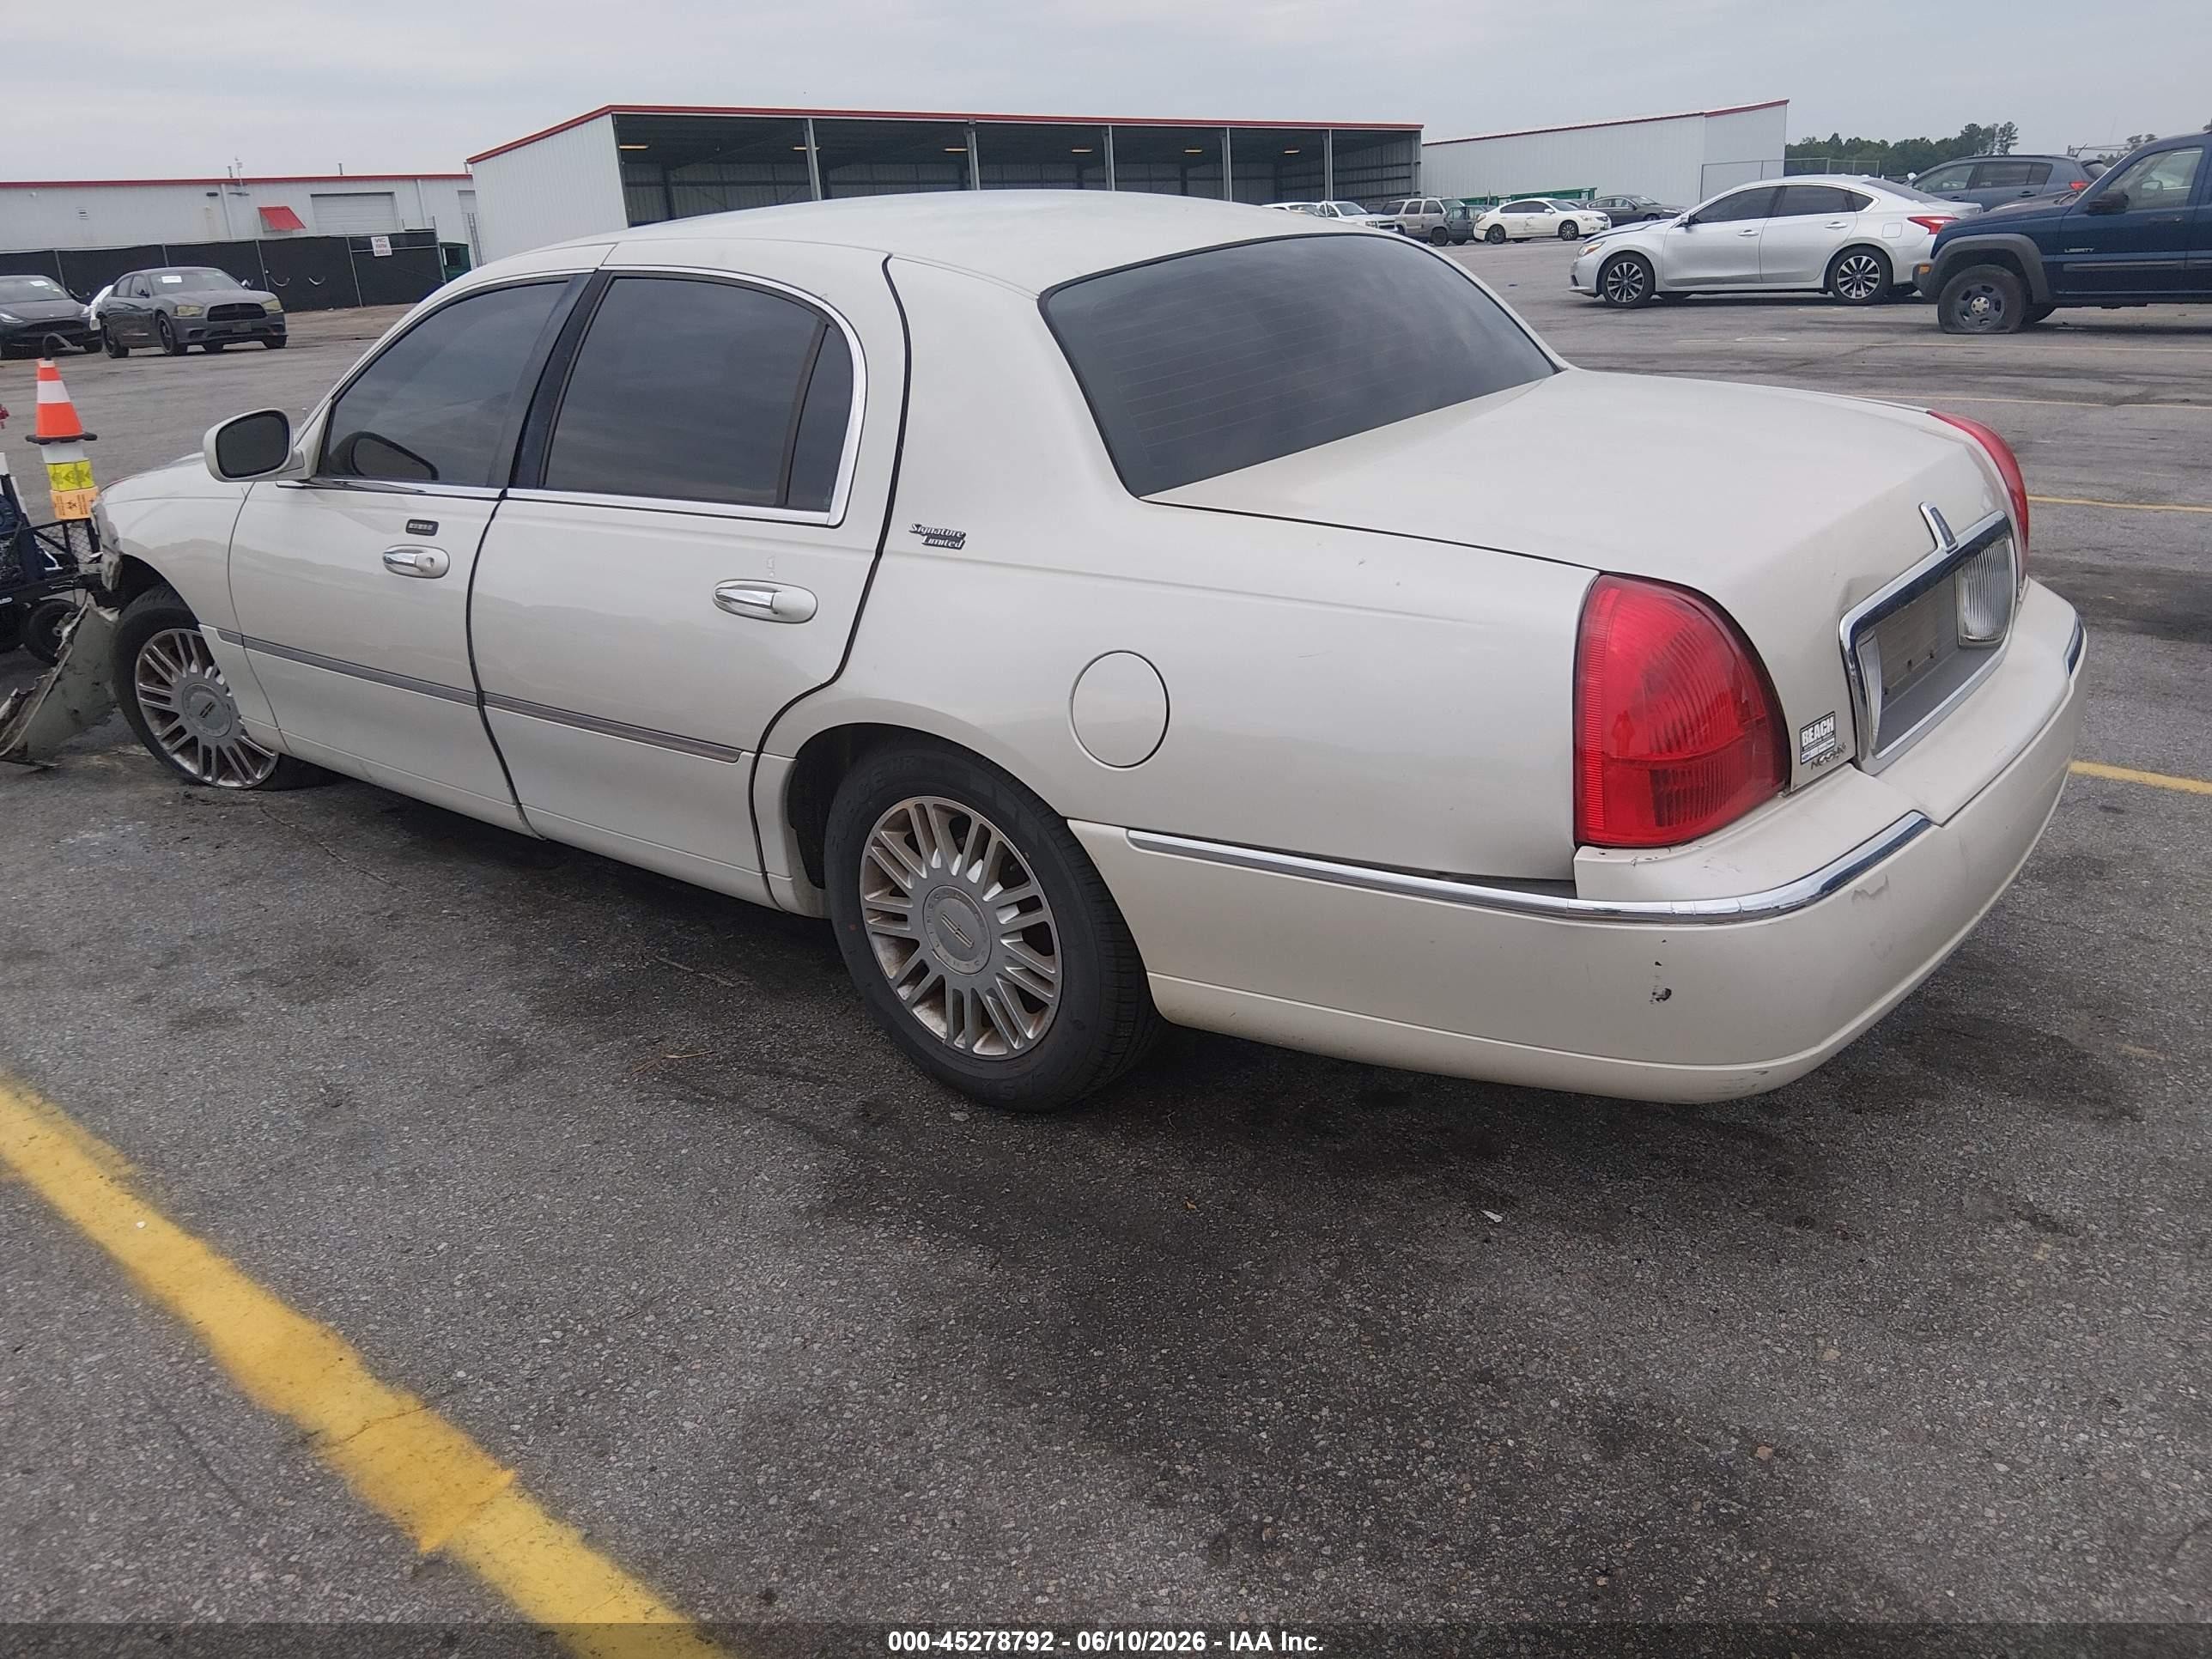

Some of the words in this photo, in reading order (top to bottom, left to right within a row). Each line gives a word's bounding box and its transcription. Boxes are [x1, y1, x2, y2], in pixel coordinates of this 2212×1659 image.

[909, 524, 965, 538] Signature
[921, 534, 964, 549] Limited
[1802, 715, 1834, 748] BEACH
